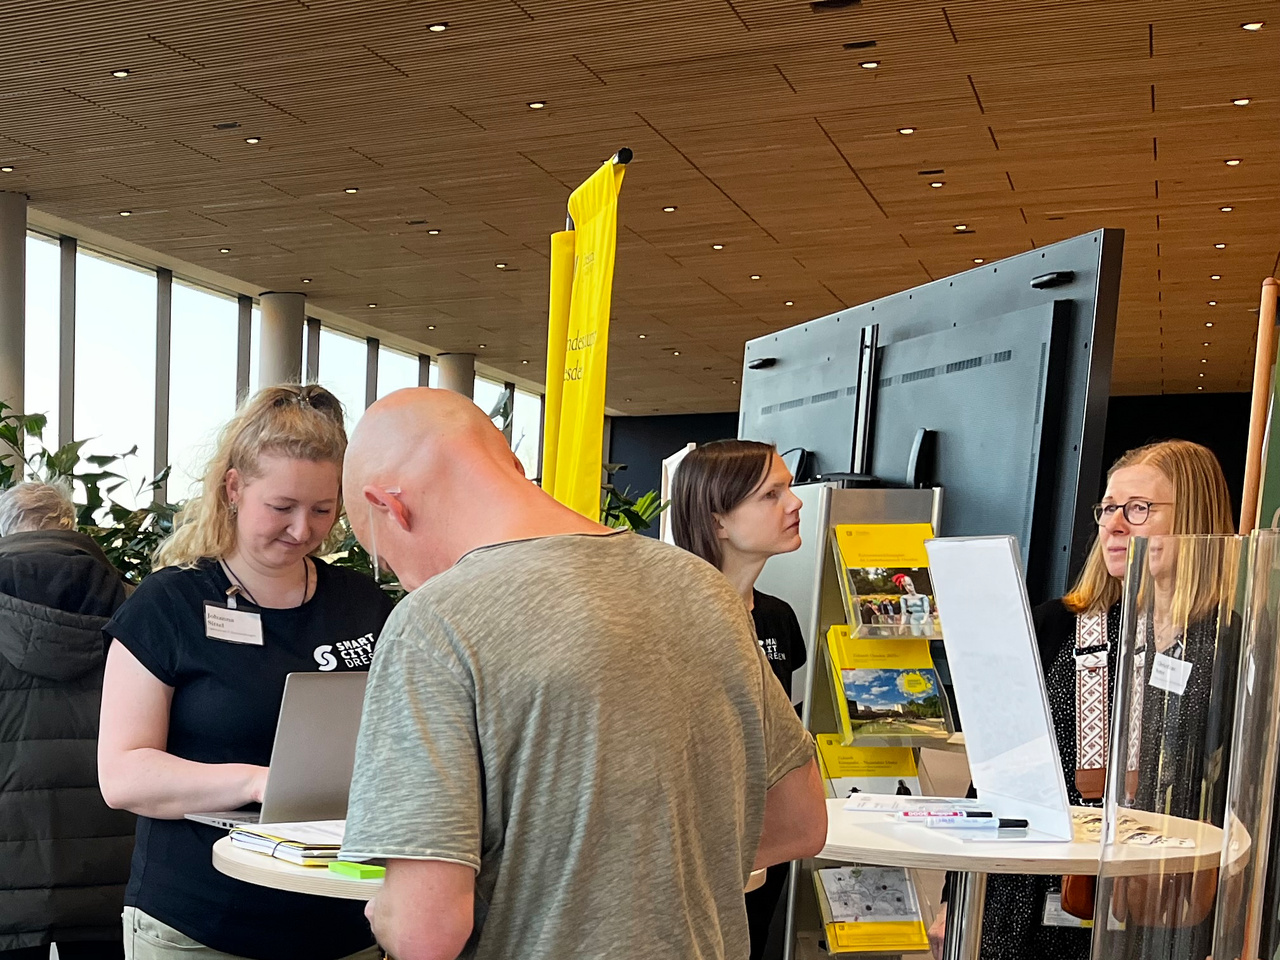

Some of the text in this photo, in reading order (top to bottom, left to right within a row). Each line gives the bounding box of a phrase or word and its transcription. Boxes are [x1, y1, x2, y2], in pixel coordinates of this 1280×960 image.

[336, 633, 374, 651] SMART
[341, 644, 372, 659] CITY
[345, 653, 374, 668] DRES
